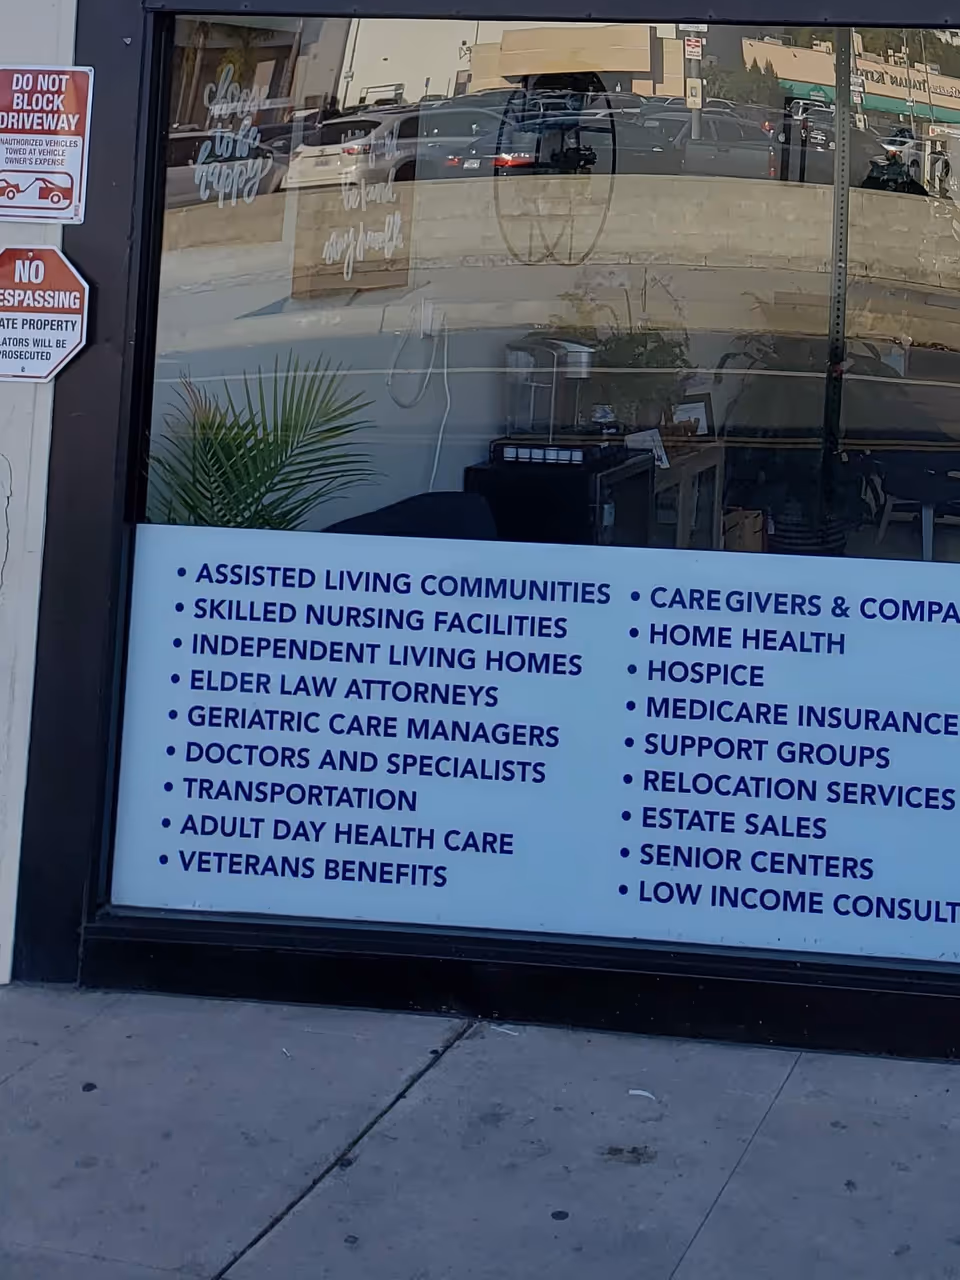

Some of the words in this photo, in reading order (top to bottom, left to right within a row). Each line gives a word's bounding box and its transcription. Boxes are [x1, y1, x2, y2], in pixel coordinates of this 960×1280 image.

[12, 74, 32, 92] DO
[37, 74, 70, 93] NOT
[13, 93, 65, 111] BLOCK
[0, 112, 80, 131] DRIVEWAY
[5, 147, 27, 156] TOWED
[28, 148, 38, 157] AT
[38, 149, 67, 158] VEHICLE
[5, 157, 34, 166] OWNER'S
[34, 158, 66, 167] EXPENSE
[45, 140, 79, 149] VEHICLES
[195, 140, 274, 209] happy
[14, 260, 45, 285] NO
[21, 318, 78, 332] PROPERTY
[0, 338, 30, 349] ATORS
[33, 338, 53, 349] WILL
[55, 339, 67, 349] BE
[194, 562, 316, 589] ASSISTED
[325, 569, 412, 595] LIVING
[420, 574, 611, 605] COMMUNITIES
[193, 597, 297, 623] SKILLED
[305, 604, 425, 631] NURSING
[434, 611, 568, 639] FACILITIES
[650, 586, 822, 617] CAREGIVERS
[830, 595, 851, 619] &
[192, 633, 382, 665] INDEPENDENT
[388, 644, 476, 670] LIVING
[485, 649, 583, 676] HOMES
[649, 623, 732, 649] HOME
[742, 628, 845, 655] HEALTH
[190, 669, 271, 695] ELDER
[279, 674, 338, 698] LAW
[343, 678, 499, 708] ATTORNEYS
[647, 659, 765, 687] HOSPICE
[187, 705, 321, 734] GERIATRIC
[328, 713, 398, 738] CARE
[406, 717, 560, 748] MANAGERS
[646, 696, 788, 726] MEDICARE
[798, 704, 959, 736] INSURANCE
[185, 741, 311, 769] DOCTORS
[317, 749, 378, 773] AND
[386, 752, 546, 784] SPECIALISTS
[644, 732, 769, 761] SUPPORT
[776, 741, 890, 770] GROUPS
[182, 777, 417, 812] TRANSPORTATION
[643, 769, 817, 802] RELOCATION
[826, 780, 956, 811] SERVICES
[179, 813, 266, 839] ADULT
[272, 818, 327, 843] DAY
[334, 822, 435, 850] HEALTH
[443, 829, 514, 855] CARE
[642, 806, 736, 834] ESTATE
[744, 813, 827, 840] SALES
[178, 849, 316, 879] VETERANS
[324, 858, 448, 888] BENEFITS
[639, 843, 742, 872] SENIOR
[750, 850, 875, 881] CENTERS
[639, 880, 703, 906] LOW
[710, 885, 824, 915] INCOME
